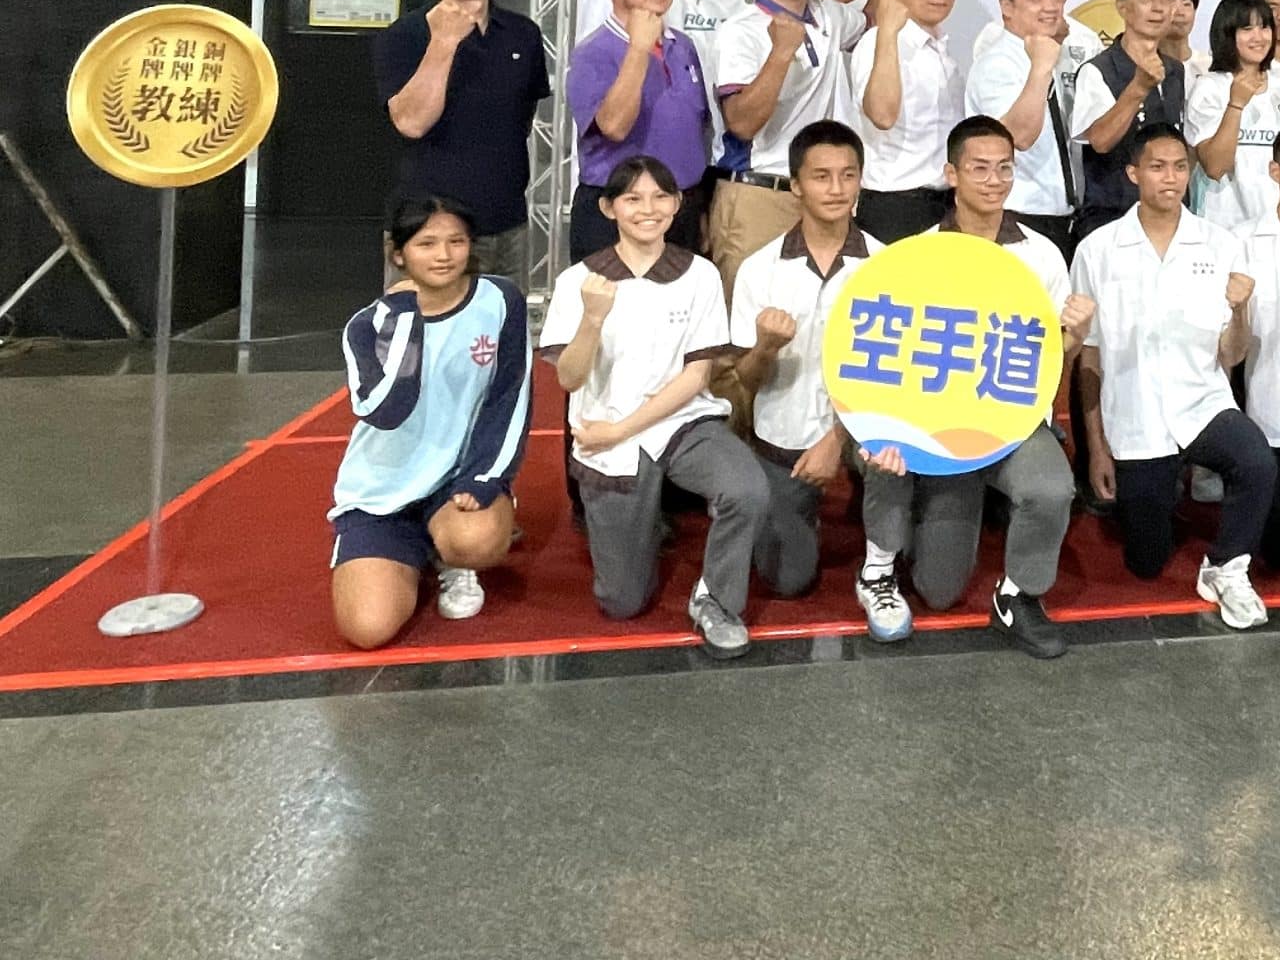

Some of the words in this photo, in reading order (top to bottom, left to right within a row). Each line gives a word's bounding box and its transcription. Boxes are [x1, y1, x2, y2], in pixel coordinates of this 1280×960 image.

[131, 84, 222, 124] 教練
[838, 294, 1046, 406] 空手道
